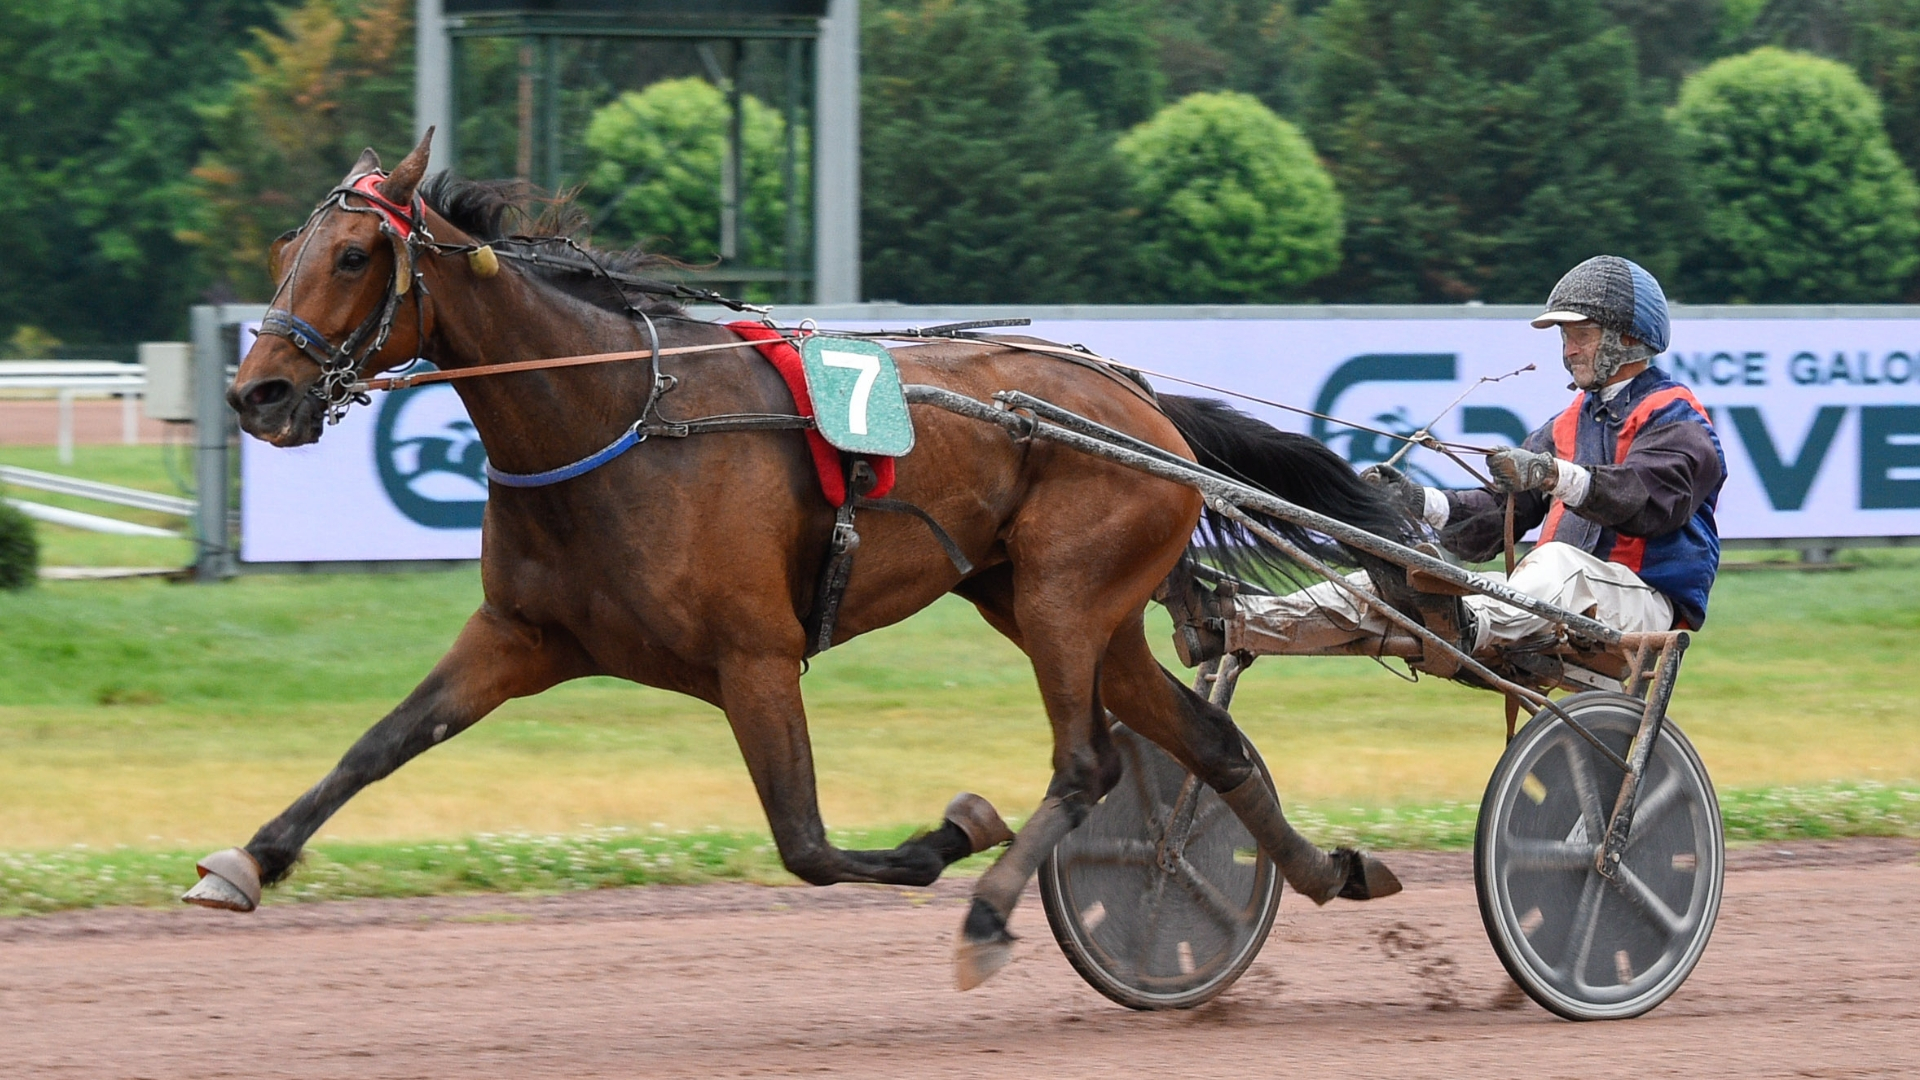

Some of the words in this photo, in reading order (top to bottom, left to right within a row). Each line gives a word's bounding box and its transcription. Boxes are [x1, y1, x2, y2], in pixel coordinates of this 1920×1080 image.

[1650, 352, 1766, 386] NCE
[1789, 351, 1920, 386] GALO
[820, 350, 881, 435] 7
[1465, 572, 1538, 608] YANKEE
